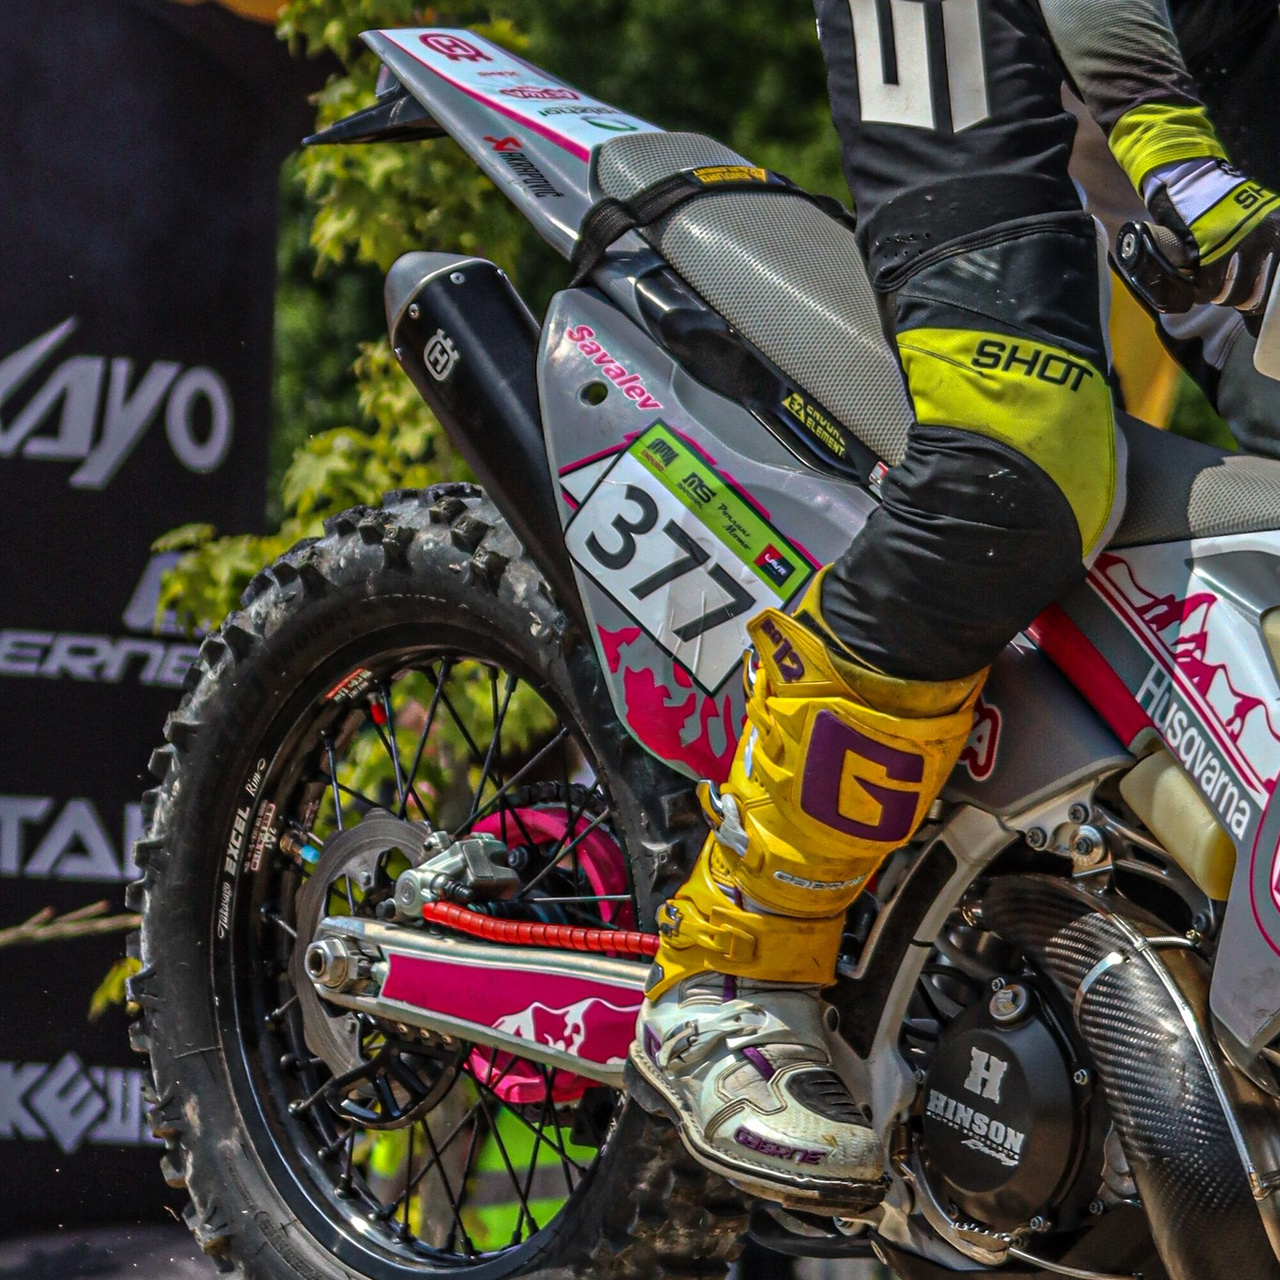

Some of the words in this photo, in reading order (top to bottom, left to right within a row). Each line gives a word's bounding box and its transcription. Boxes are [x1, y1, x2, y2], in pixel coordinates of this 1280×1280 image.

[970, 339, 1094, 393] SHOT
[805, 417, 847, 459] ELEMENT
[584, 483, 757, 643] 377
[1134, 660, 1252, 841] Husqvarna
[224, 805, 251, 876] EXCEL
[217, 881, 232, 940] Takasago
[926, 1088, 1025, 1154] HINSON
